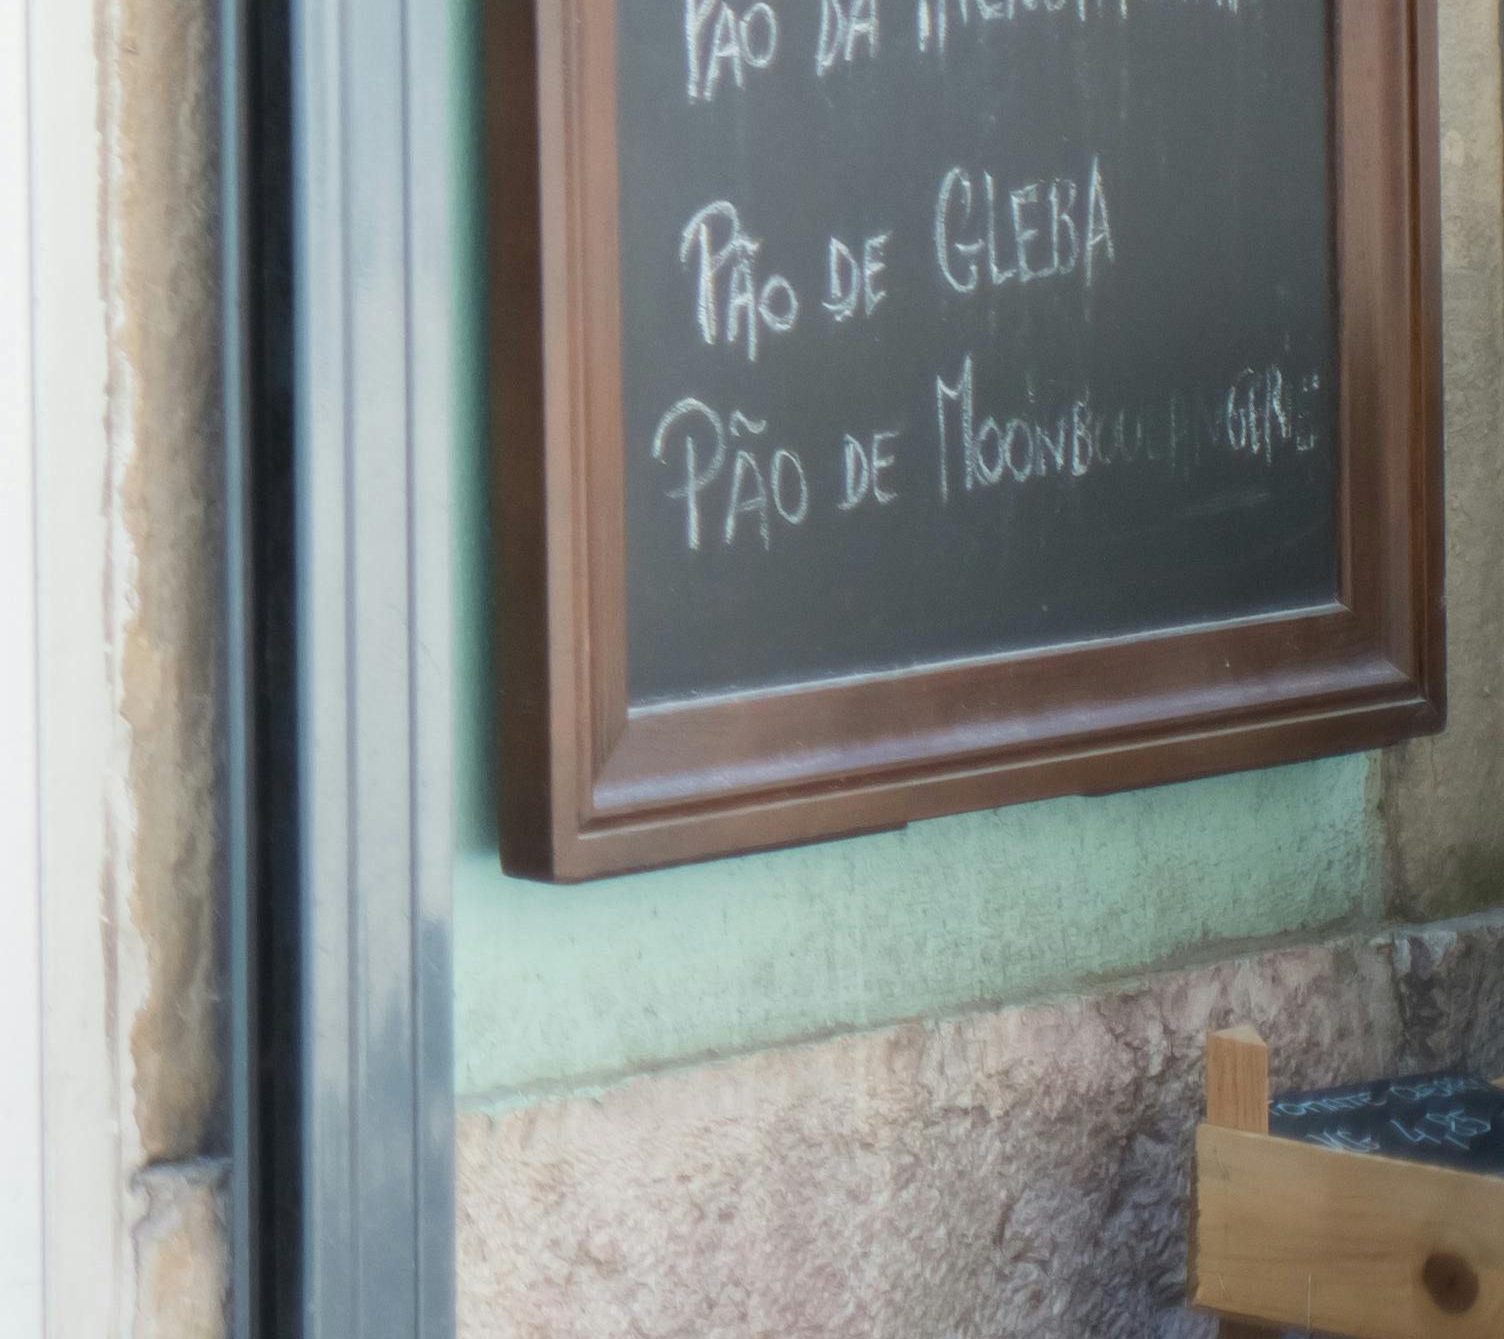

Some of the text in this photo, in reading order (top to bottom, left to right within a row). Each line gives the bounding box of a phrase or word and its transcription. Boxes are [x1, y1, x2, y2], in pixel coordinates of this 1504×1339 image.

[822, 229, 890, 323] DE
[933, 157, 1115, 295] GLEBA
[653, 396, 808, 551] PÃO
[839, 428, 899, 512] DE
